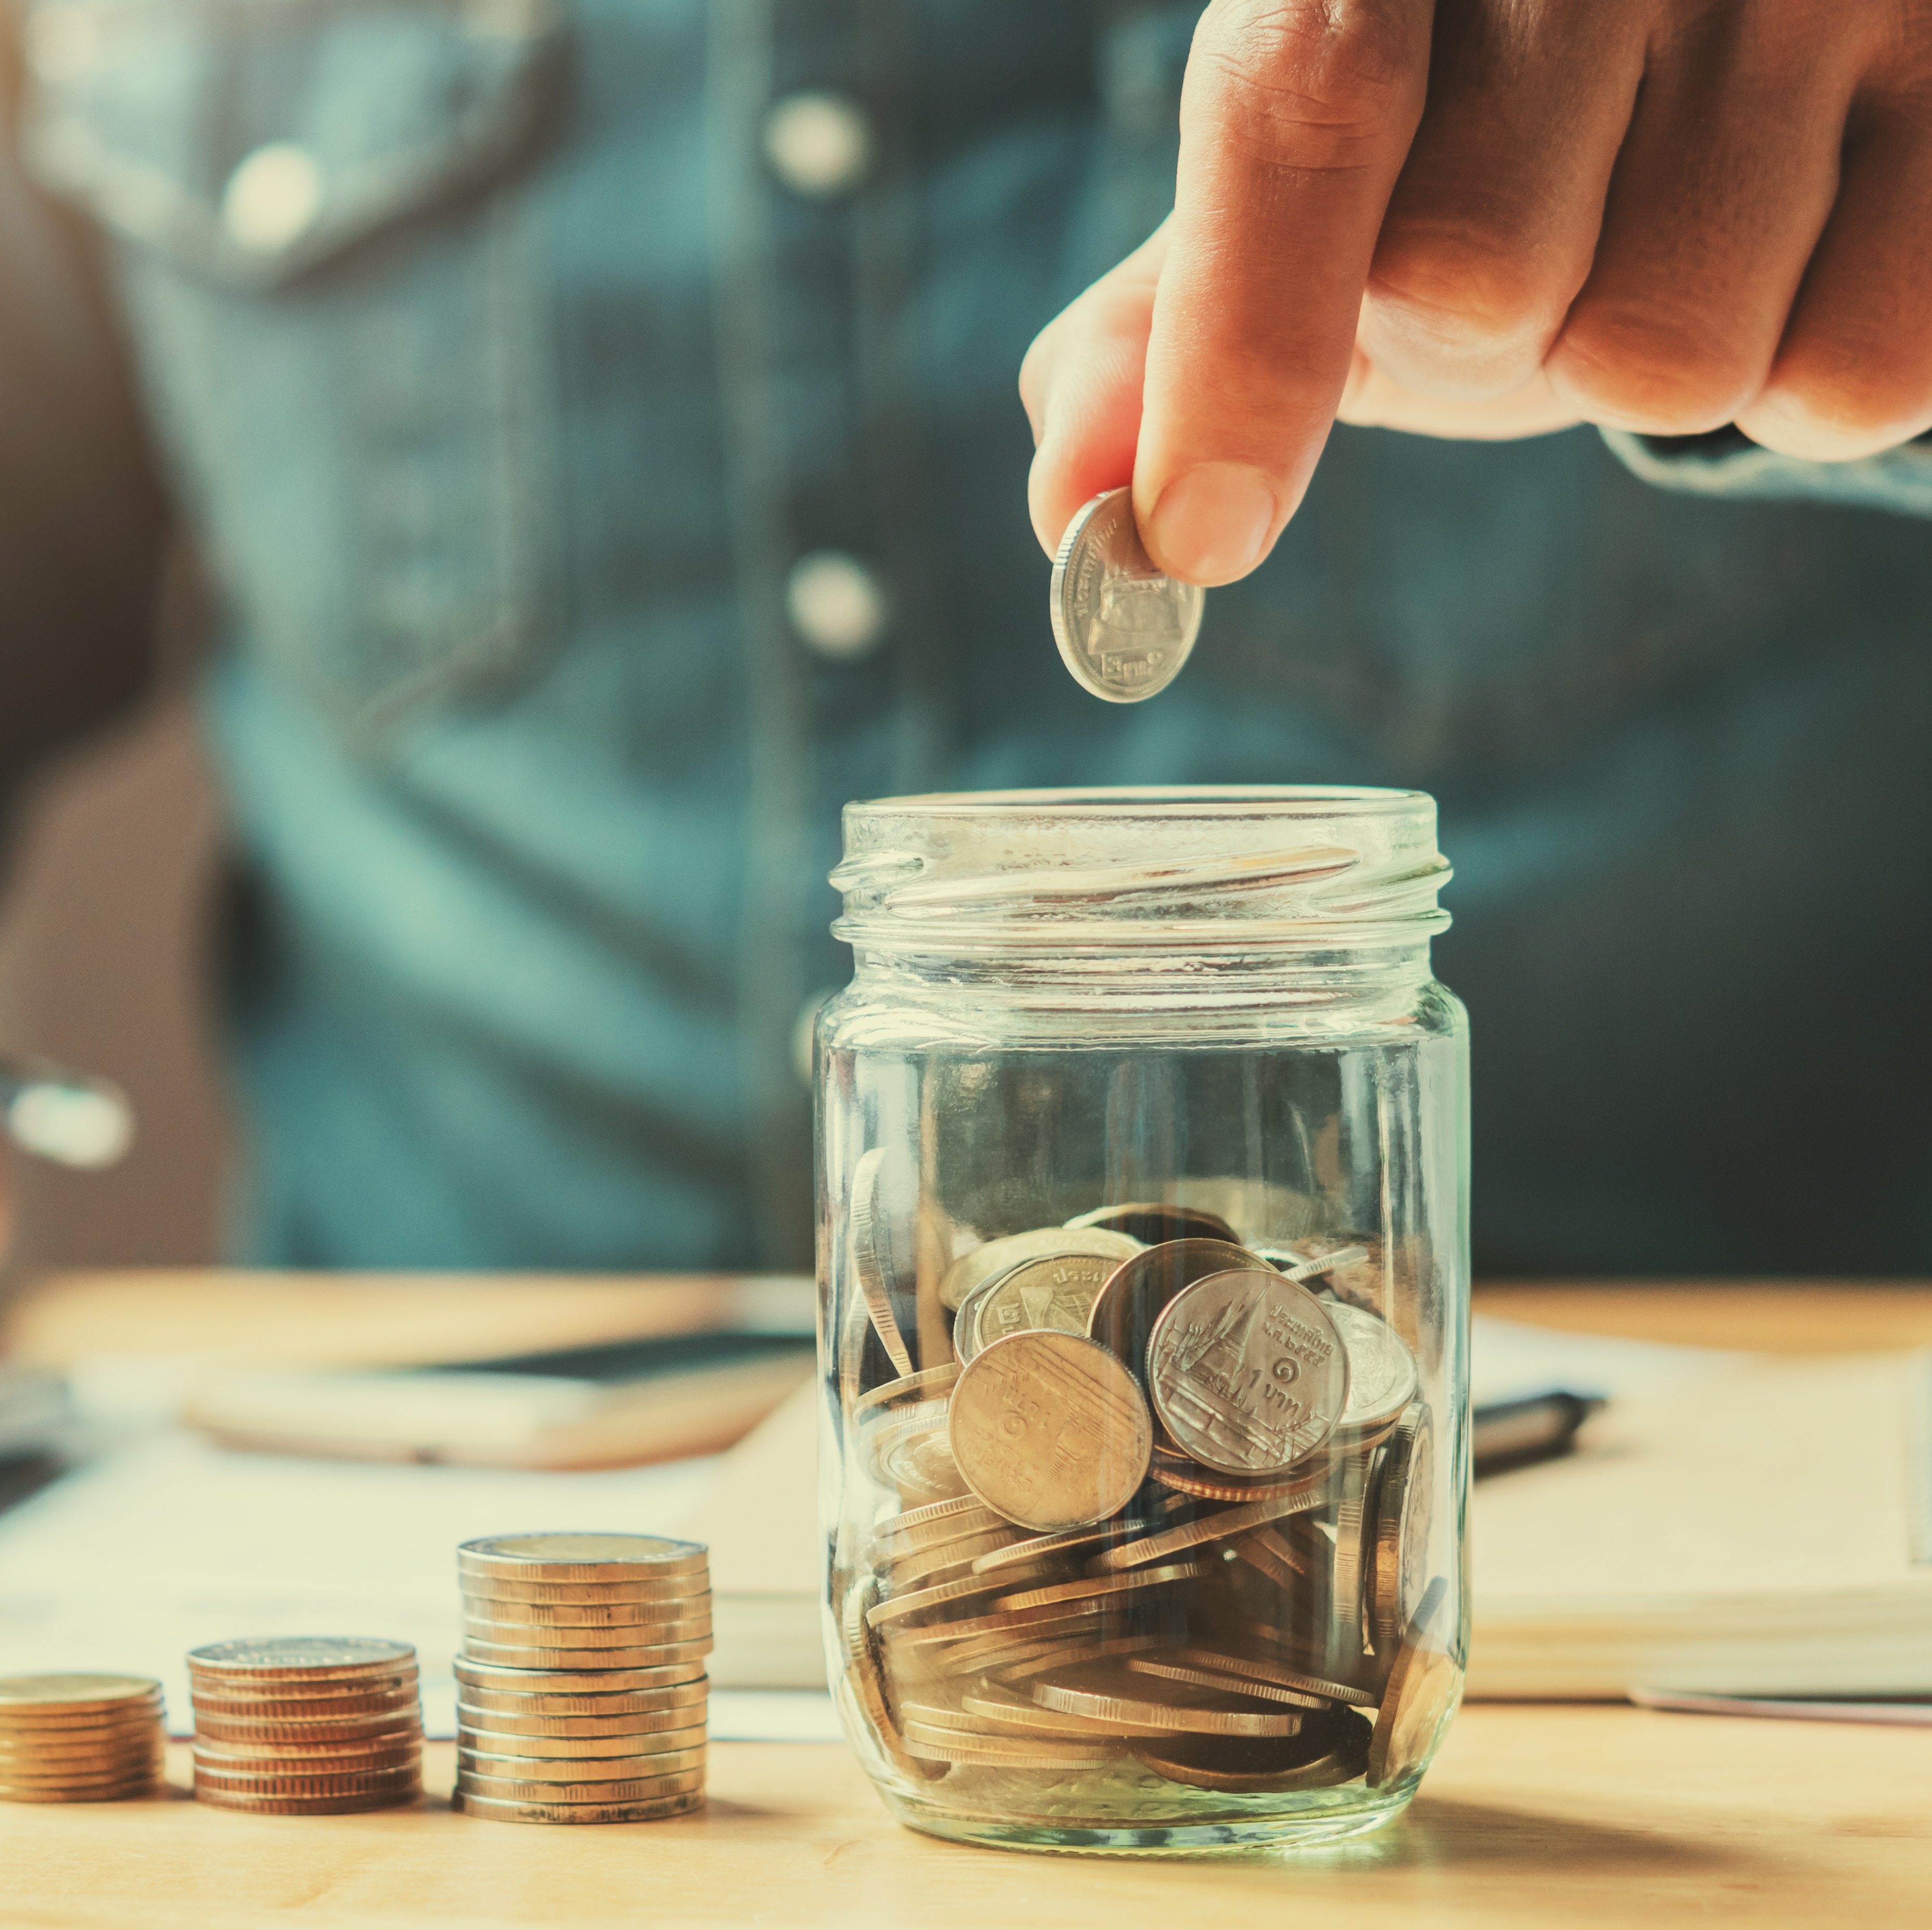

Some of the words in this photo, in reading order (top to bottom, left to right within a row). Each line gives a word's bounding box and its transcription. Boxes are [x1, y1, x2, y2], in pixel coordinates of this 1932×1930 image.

[1271, 1304, 1333, 1356] ประเทศไทย
[1264, 1383, 1300, 1415] บาท
